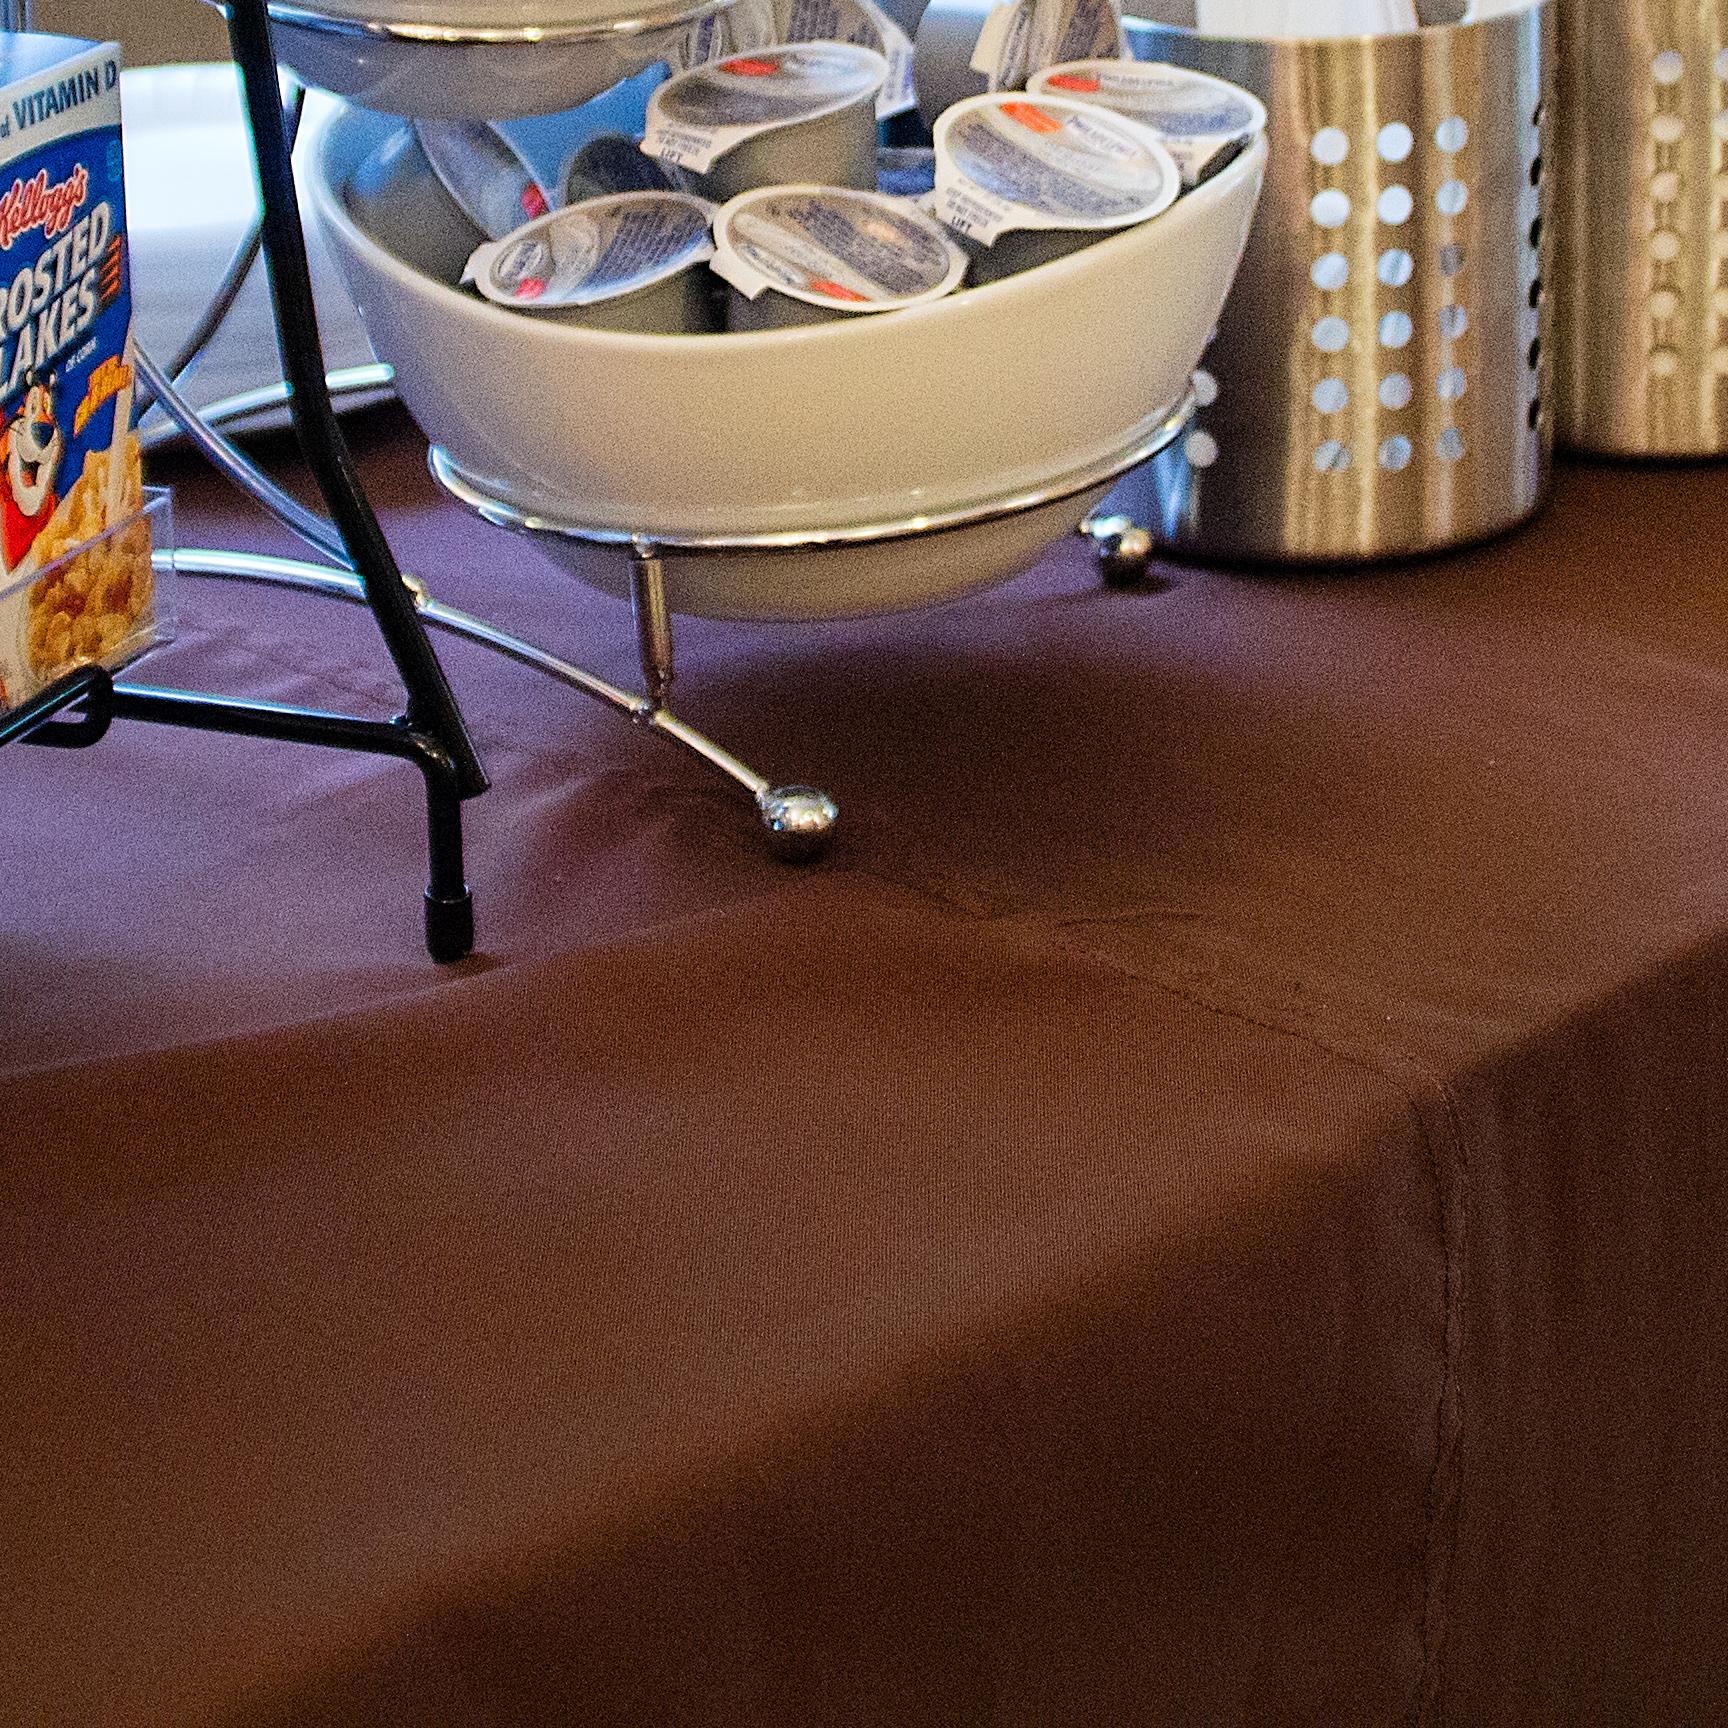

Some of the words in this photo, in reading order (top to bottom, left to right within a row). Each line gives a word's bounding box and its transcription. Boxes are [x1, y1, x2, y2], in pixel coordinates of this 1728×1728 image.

[0, 116, 10, 143] of
[12, 69, 99, 131] VITAMIN
[104, 58, 117, 92] D
